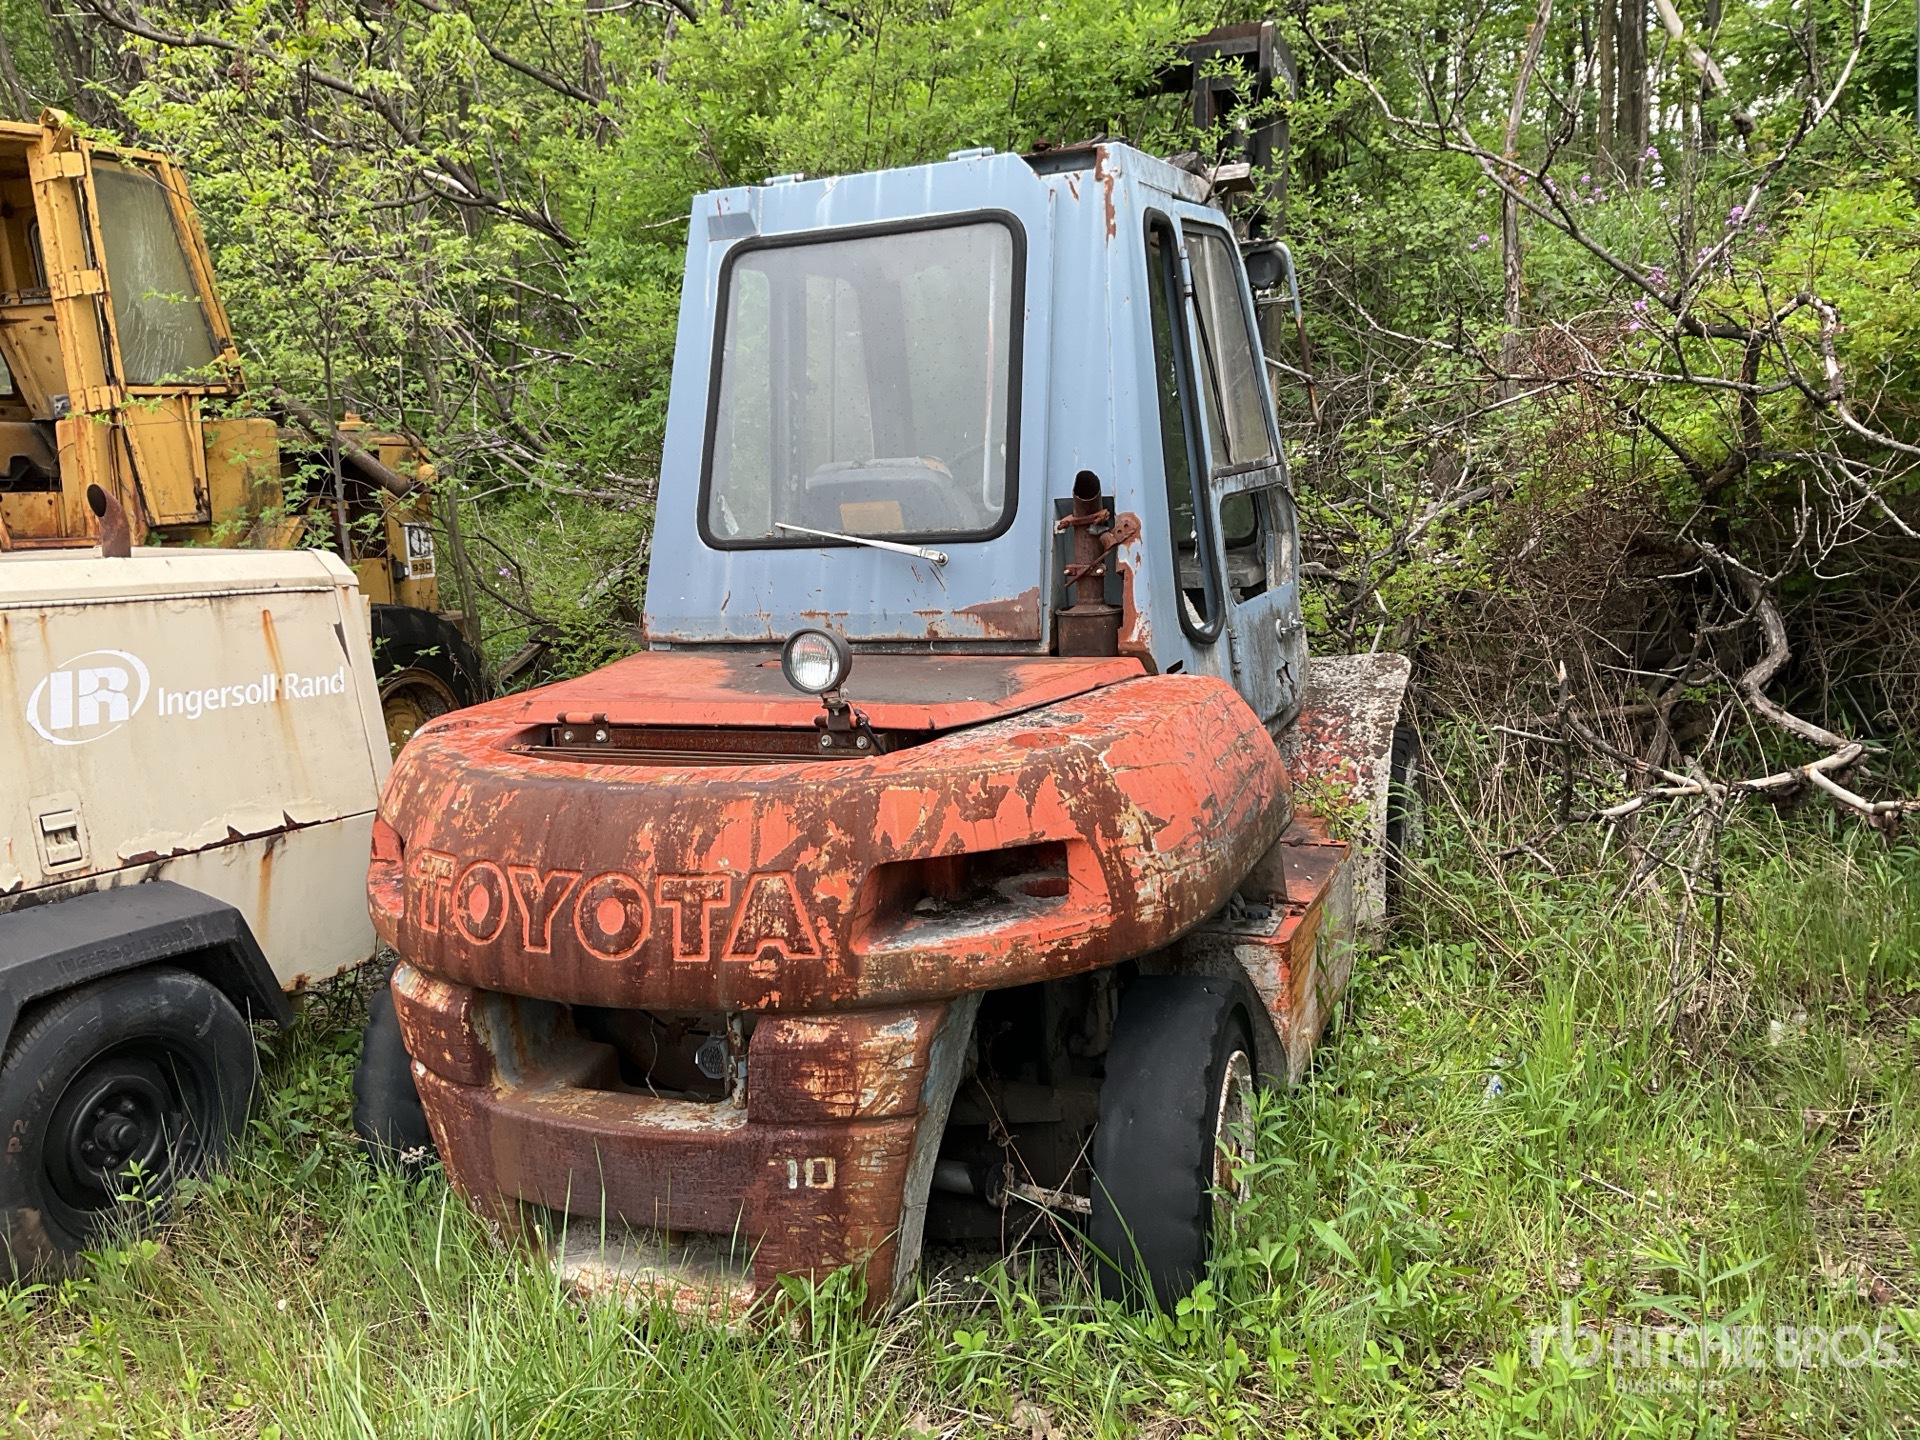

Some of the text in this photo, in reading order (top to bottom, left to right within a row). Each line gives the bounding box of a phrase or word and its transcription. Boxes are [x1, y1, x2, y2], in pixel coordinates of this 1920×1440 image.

[158, 665, 345, 721] Ingersoll Rand
[412, 848, 822, 962] TOYOTA
